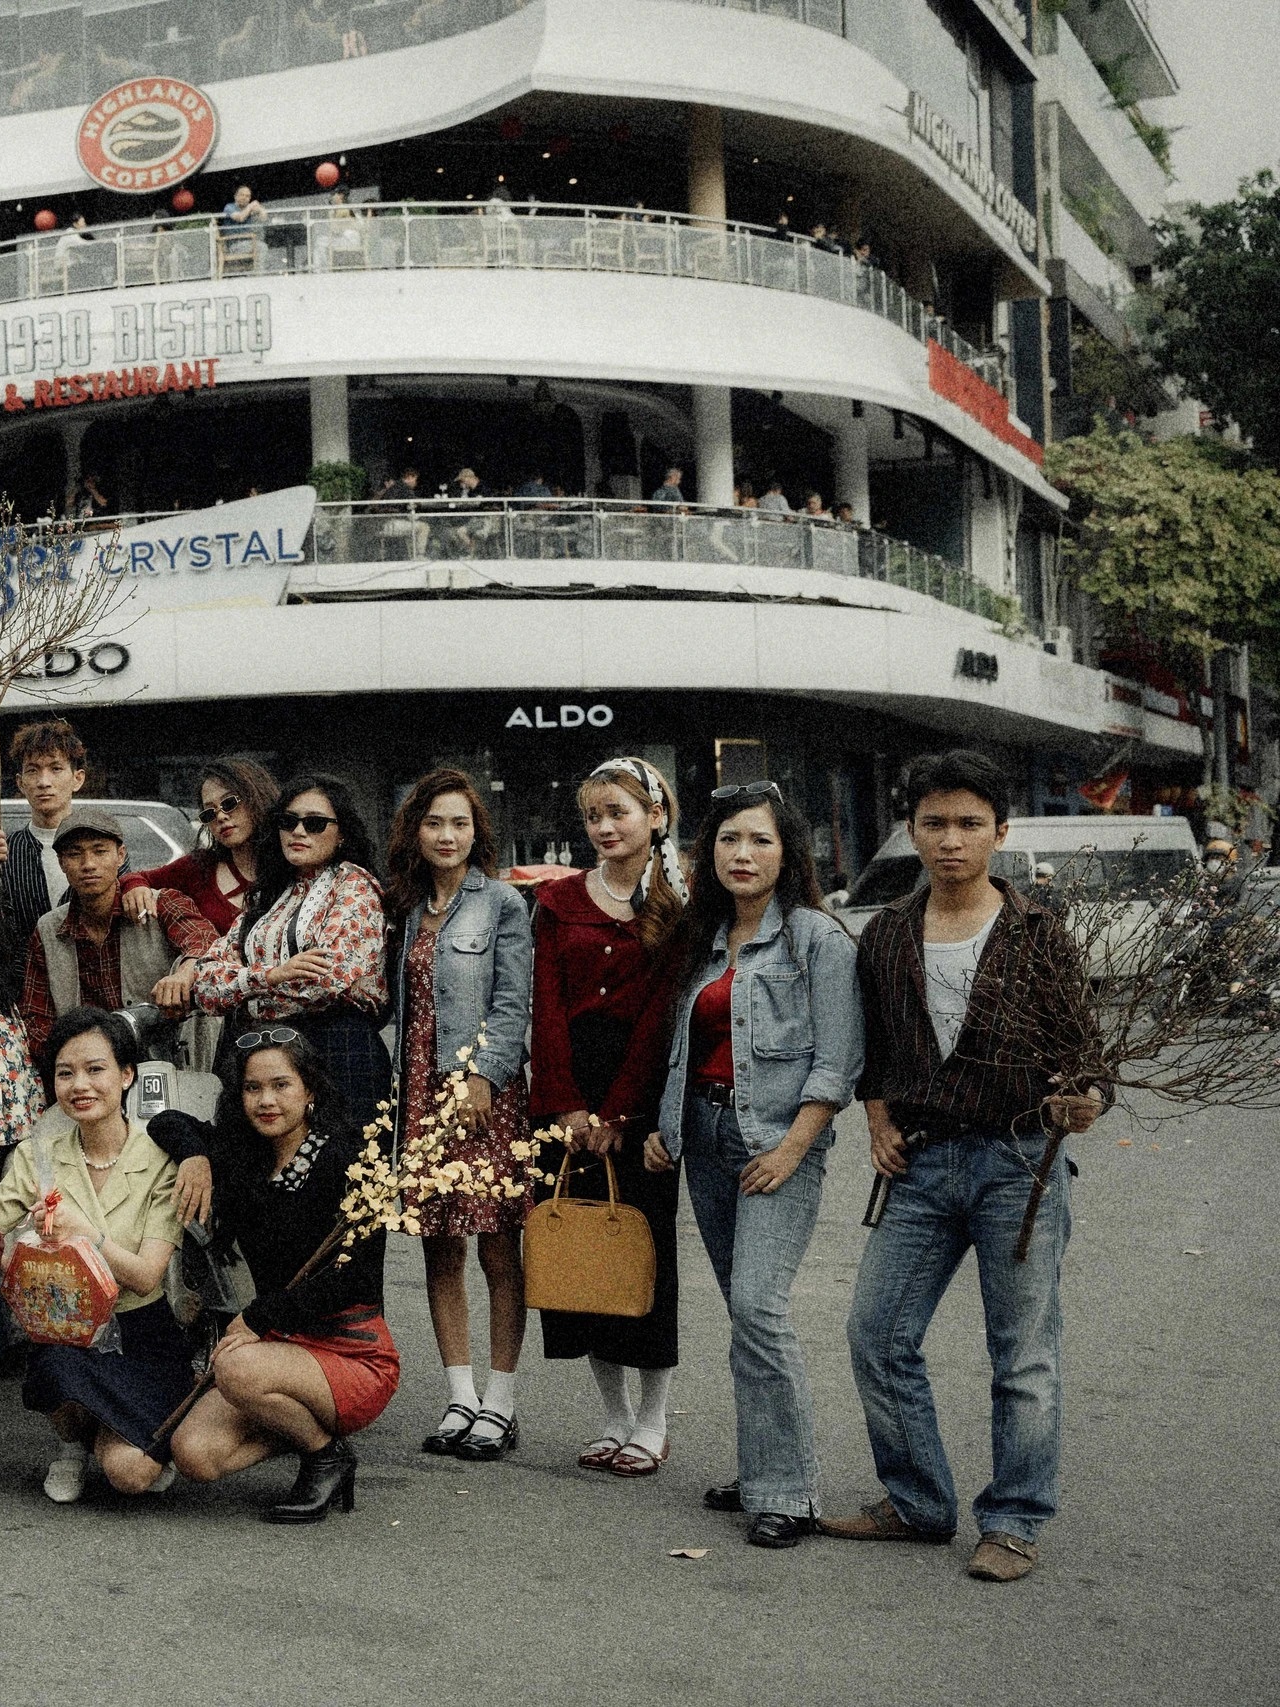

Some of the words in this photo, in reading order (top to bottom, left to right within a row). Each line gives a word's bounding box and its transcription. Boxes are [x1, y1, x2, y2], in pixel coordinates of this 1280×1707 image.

[84, 82, 208, 139] HIGHLANDS
[100, 151, 196, 186] COFFEE
[111, 293, 273, 363] BISTRO
[4, 383, 26, 411] &
[34, 358, 220, 408] RESTAURANT
[98, 527, 300, 575] CRYSTAL
[505, 704, 614, 728] ALDO
[144, 1078, 161, 1094] 50
